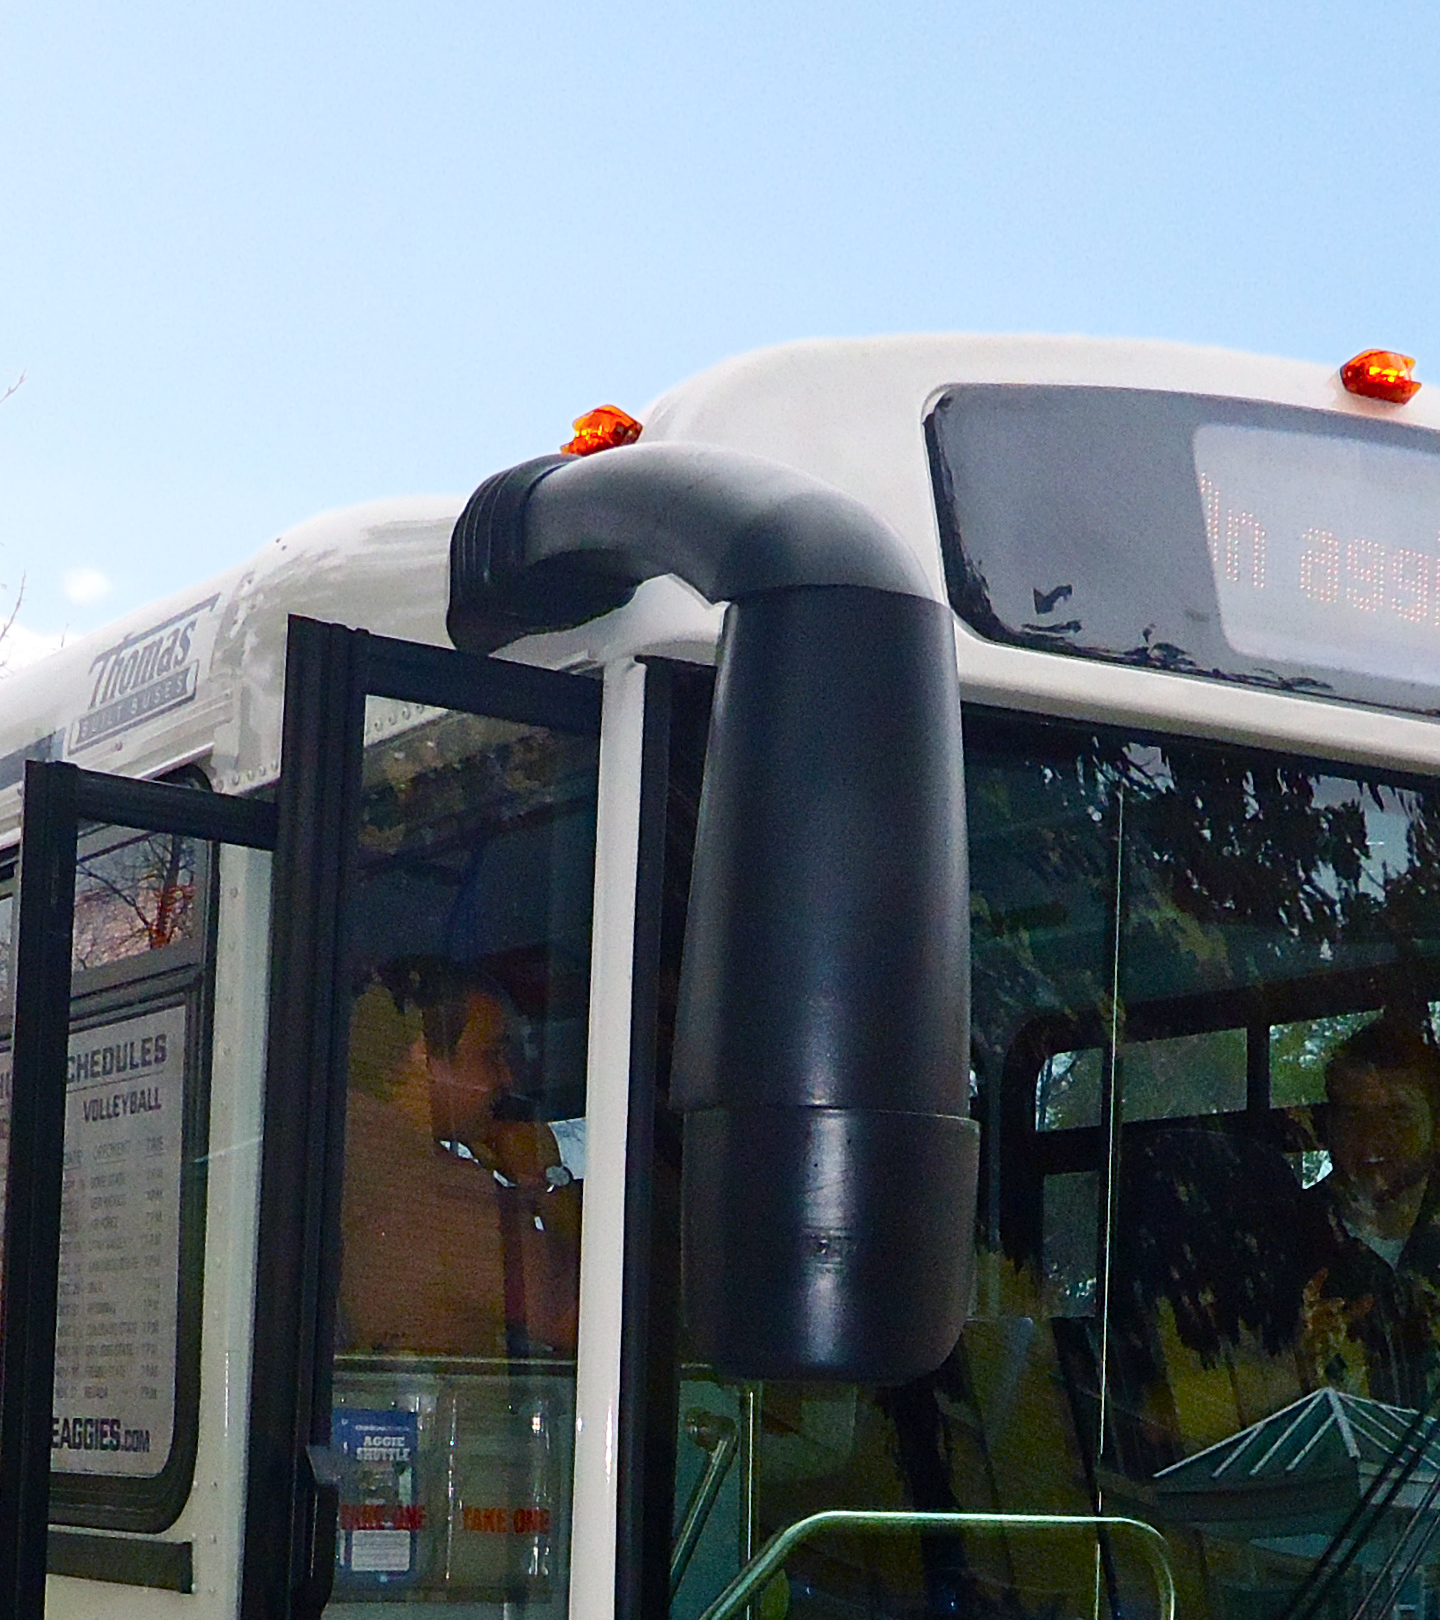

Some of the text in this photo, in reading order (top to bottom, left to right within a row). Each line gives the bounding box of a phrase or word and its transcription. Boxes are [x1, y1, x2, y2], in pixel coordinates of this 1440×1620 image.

[88, 600, 212, 711] Thomas
[66, 1034, 167, 1085] CHEDULES
[82, 1087, 162, 1123] VOLLEYBALL
[356, 1447, 411, 1462] SHUTTLE
[363, 1435, 406, 1448] AGGIE
[463, 1506, 509, 1532] TAKE
